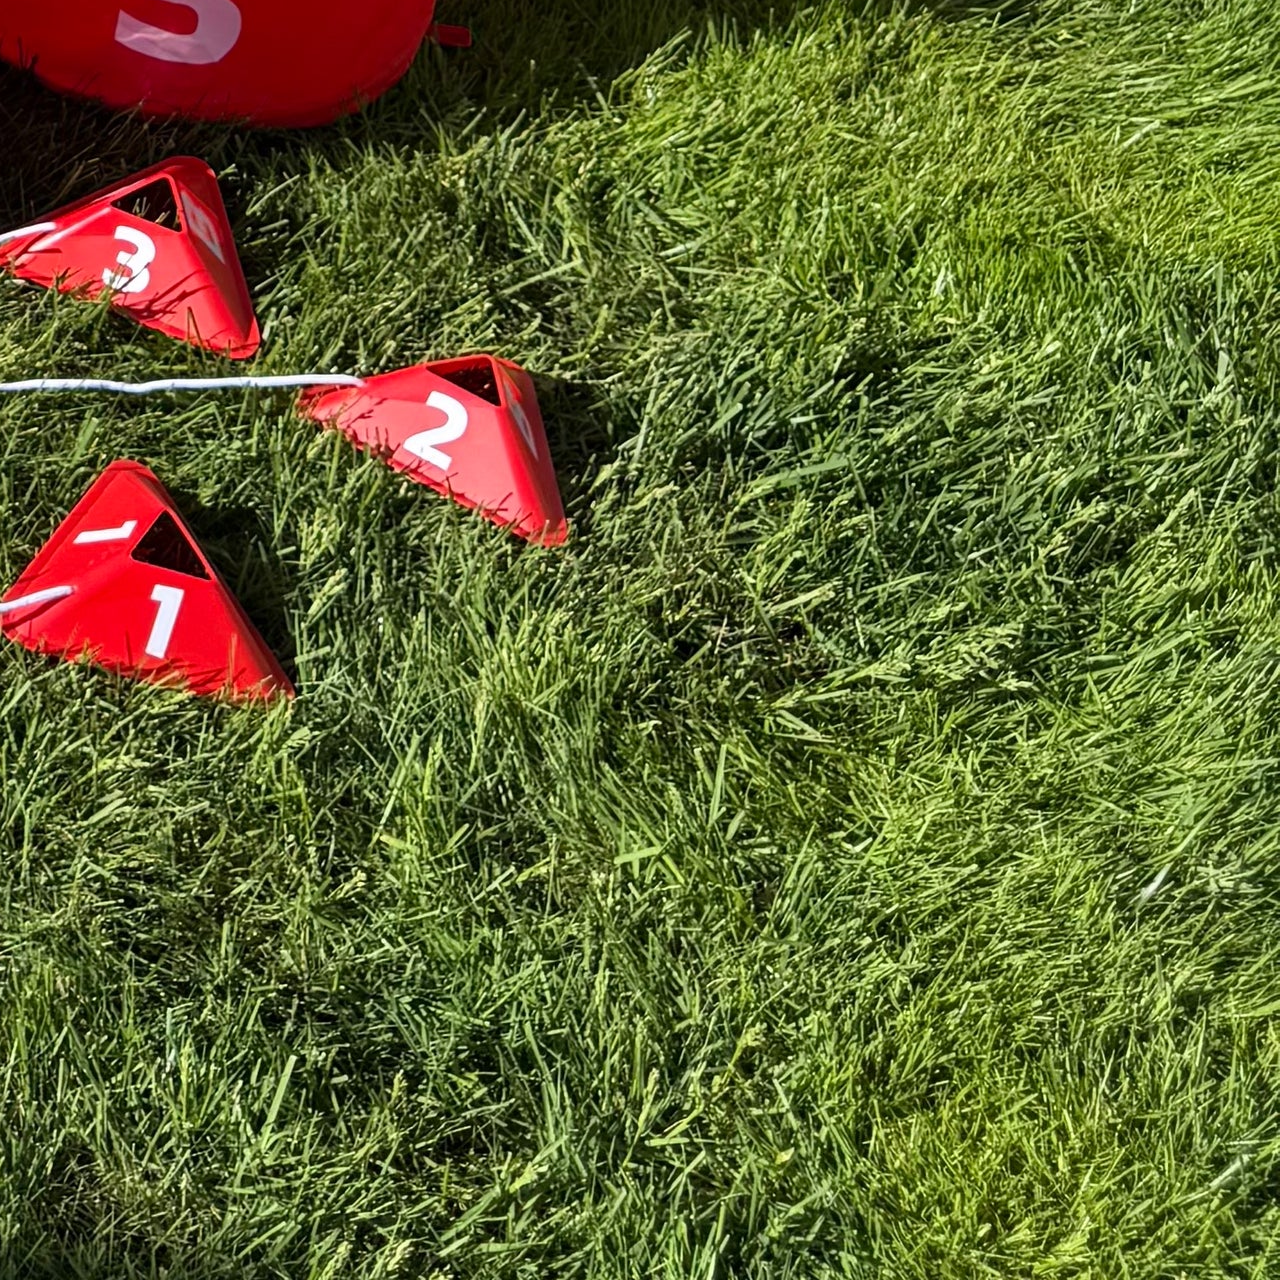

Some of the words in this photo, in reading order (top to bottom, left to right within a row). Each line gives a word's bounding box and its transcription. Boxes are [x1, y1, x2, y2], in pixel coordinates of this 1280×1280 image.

[102, 225, 156, 294] 3
[402, 390, 469, 472] 2
[144, 583, 186, 660] 1
